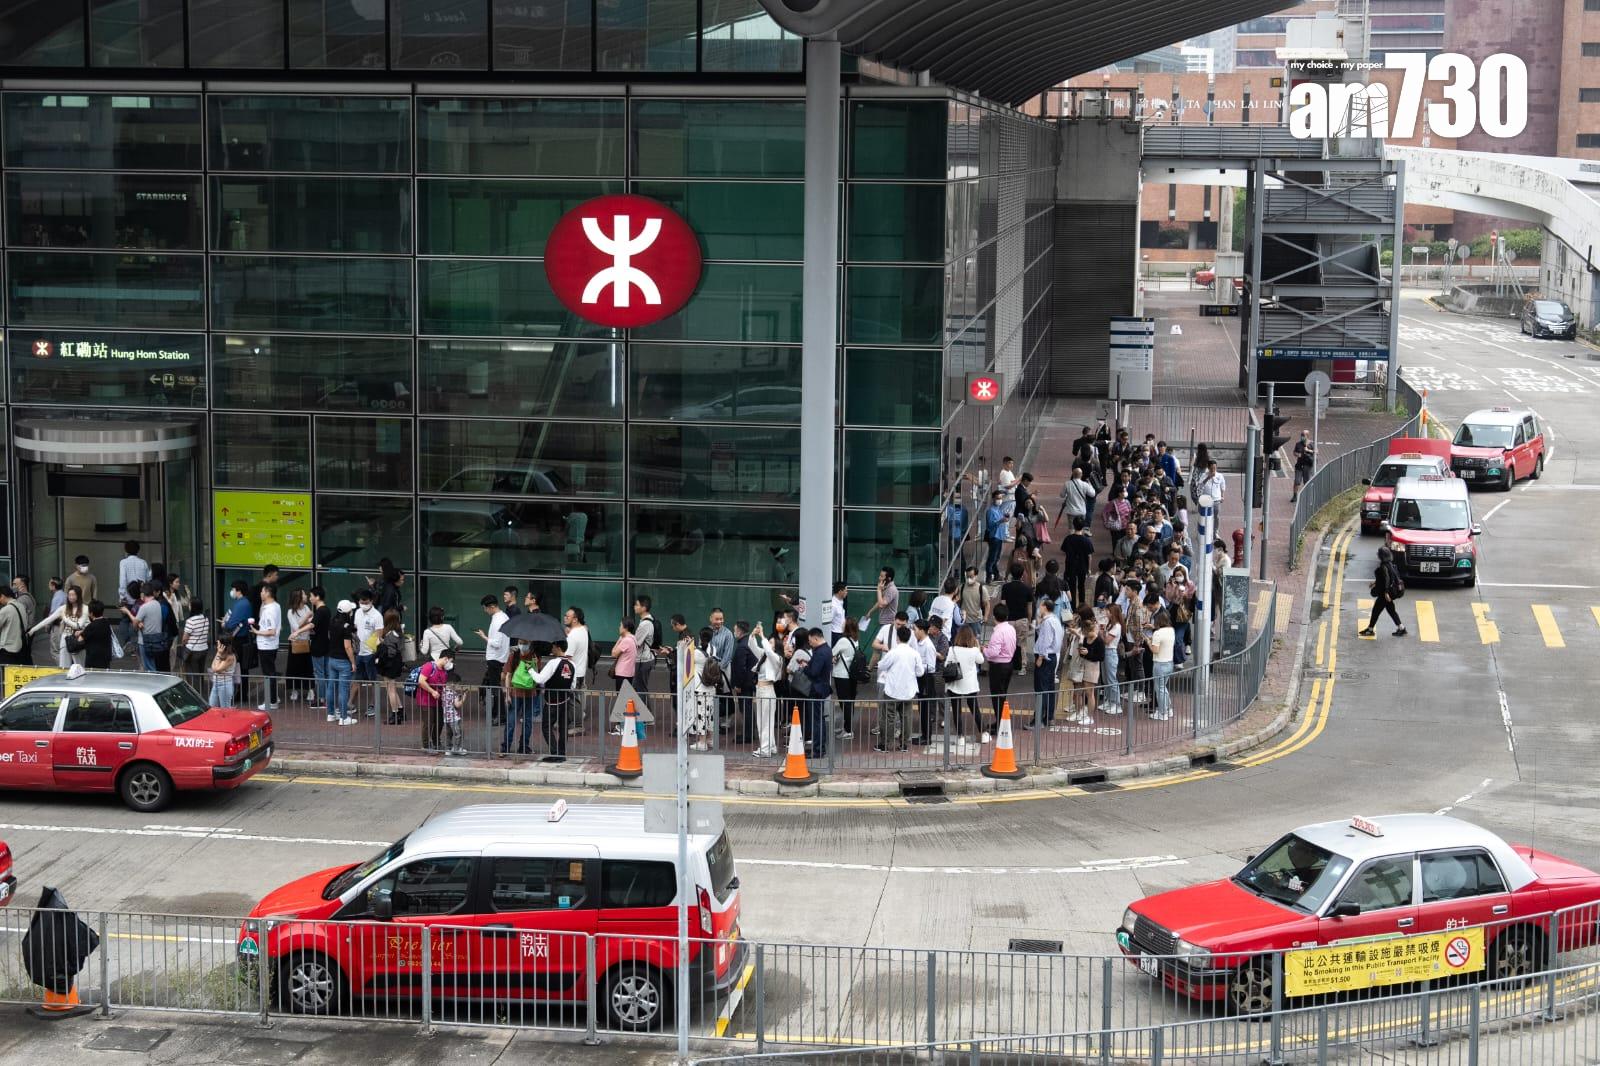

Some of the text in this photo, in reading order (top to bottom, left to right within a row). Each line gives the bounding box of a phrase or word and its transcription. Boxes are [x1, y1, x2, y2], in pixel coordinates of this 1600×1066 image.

[1241, 100, 1258, 109] LAI
[1263, 99, 1286, 109] LIN
[60, 341, 108, 359] 紅磡站
[111, 350, 190, 361] Hung Hom Station
[174, 736, 195, 748] TAXI
[195, 738, 214, 748] 的士
[16, 750, 38, 763] Taxi
[76, 747, 96, 757] 的士
[78, 756, 97, 766] TAXI
[387, 936, 453, 950] Preier
[521, 934, 547, 945] 的士
[521, 946, 548, 958] TAXI
[1303, 940, 1440, 969] 此公共運輸設施嚴禁吸煙
[1303, 969, 1313, 977] No
[1314, 966, 1343, 977] Smoking
[1352, 963, 1365, 971] this
[1366, 961, 1385, 970] Public
[1387, 957, 1417, 968] Transport
[1418, 954, 1440, 964] Facility
